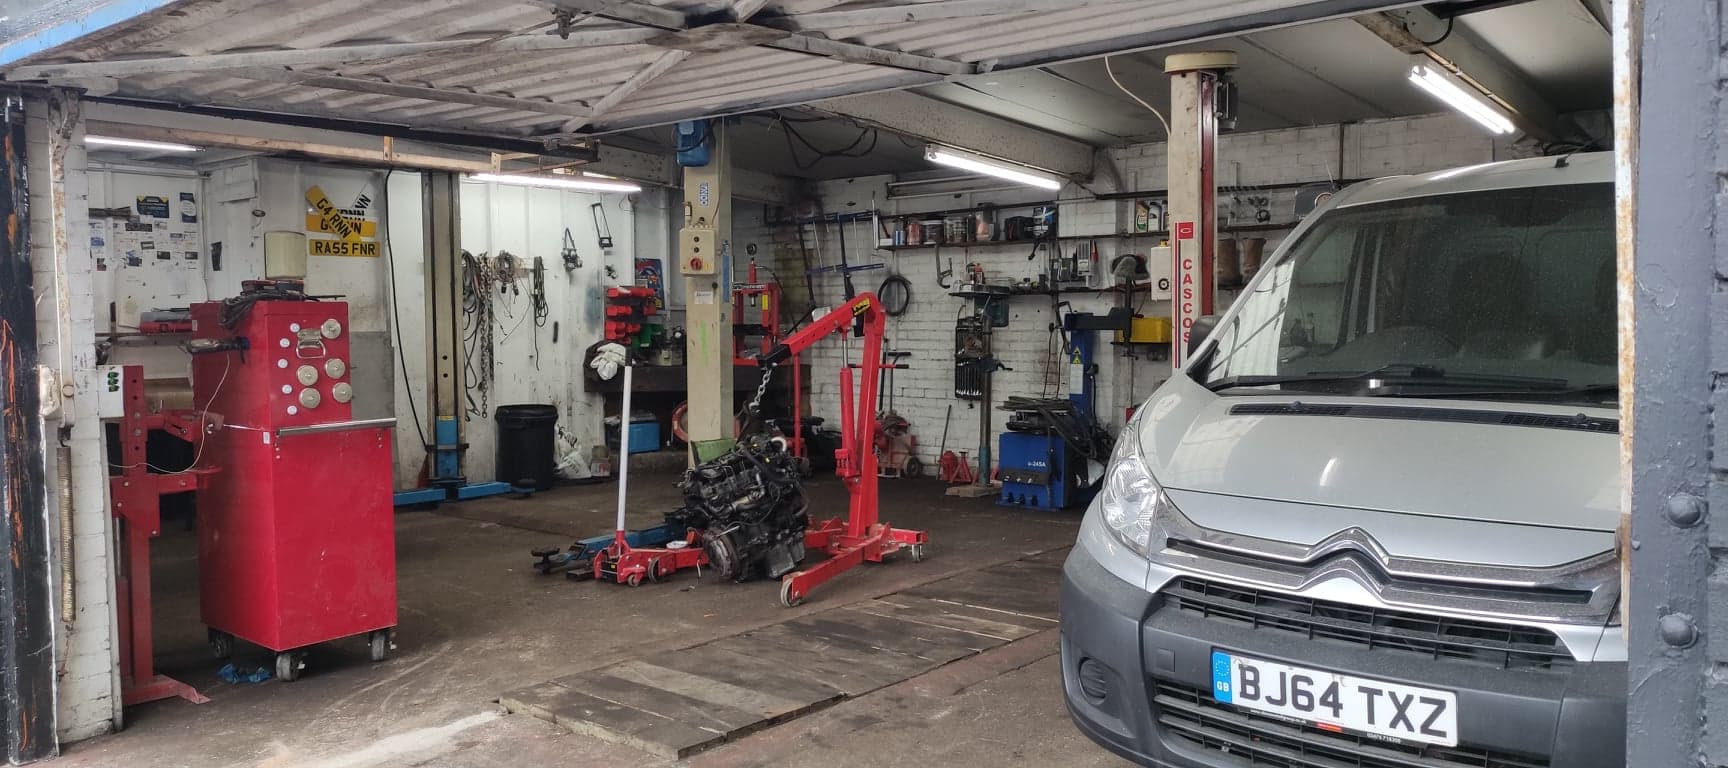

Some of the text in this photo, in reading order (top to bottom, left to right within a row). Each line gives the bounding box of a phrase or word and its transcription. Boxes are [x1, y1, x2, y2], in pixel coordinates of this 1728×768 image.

[316, 198, 352, 239] G4 RNN
[352, 243, 375, 255] FNR
[1216, 681, 1229, 692] GB
[1239, 663, 1447, 738] BJ64 TXZ
